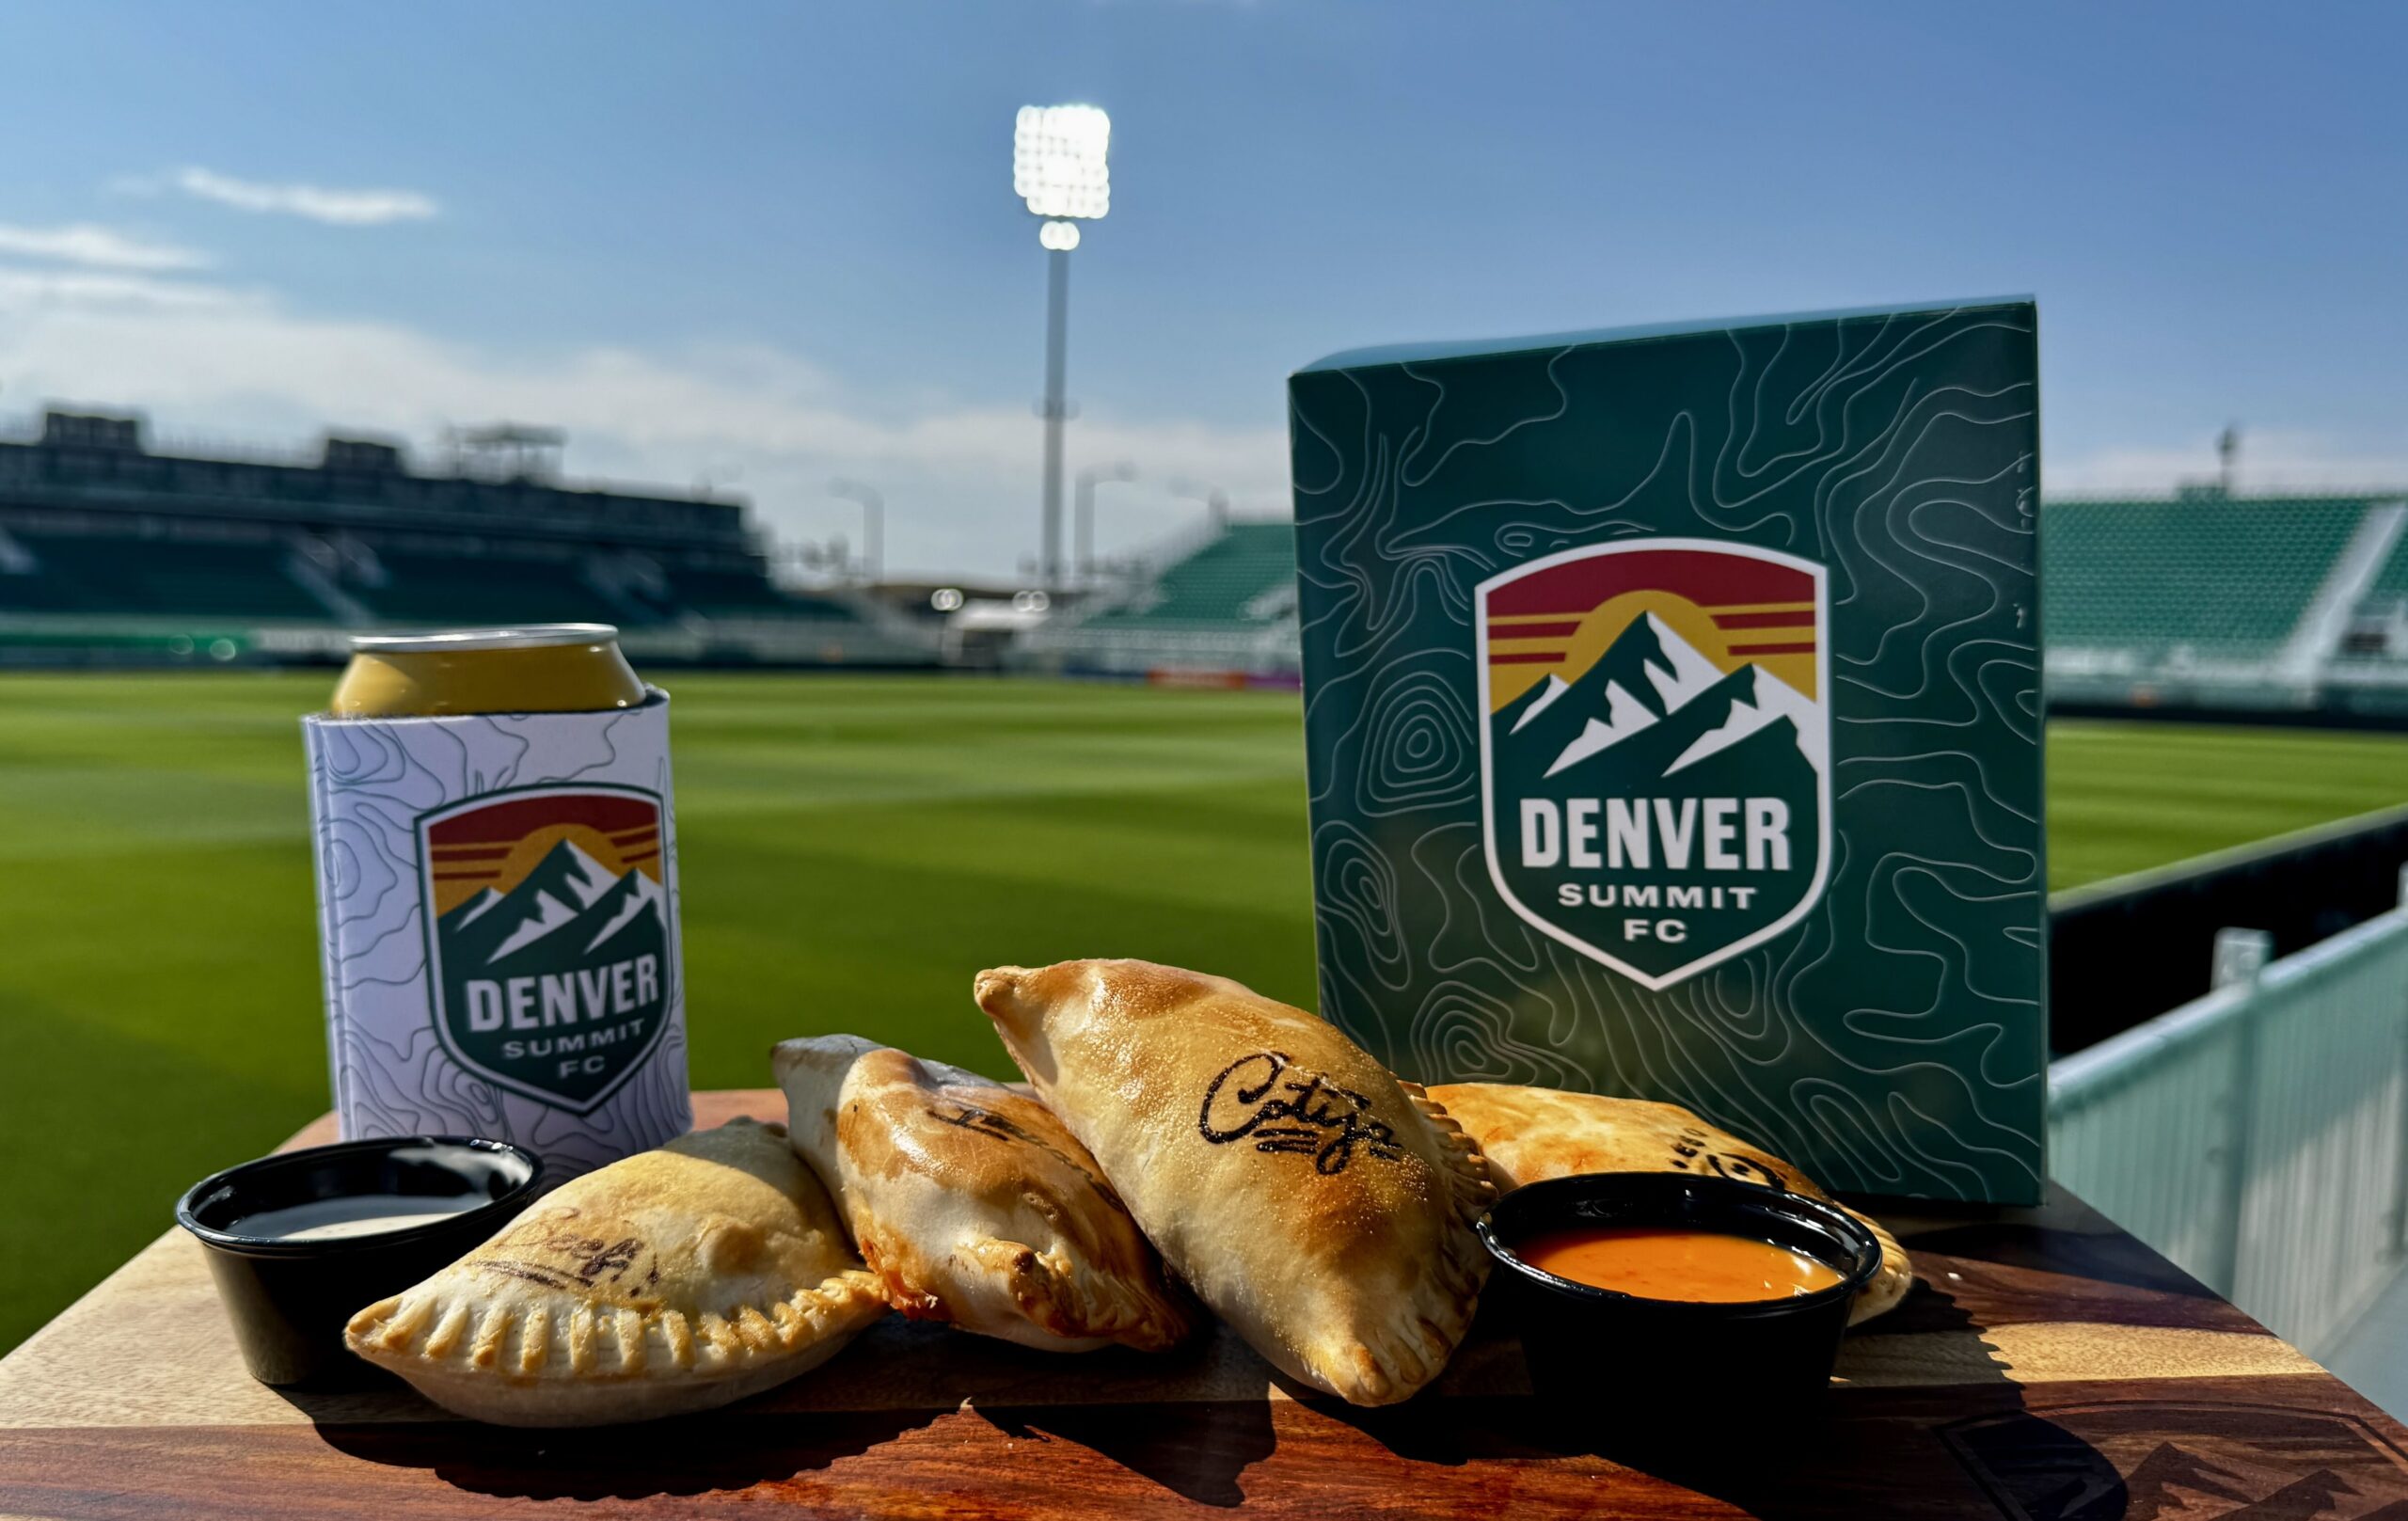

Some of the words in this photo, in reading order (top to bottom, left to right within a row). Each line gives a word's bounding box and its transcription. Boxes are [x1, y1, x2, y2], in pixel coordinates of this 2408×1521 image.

[1520, 797, 1791, 871] DENVER
[1558, 883, 1757, 910] SUMMIT
[1624, 919, 1688, 943] FC
[467, 953, 659, 1033] DENVER
[501, 1018, 646, 1059] SUMMIT
[559, 1054, 607, 1079] FC
